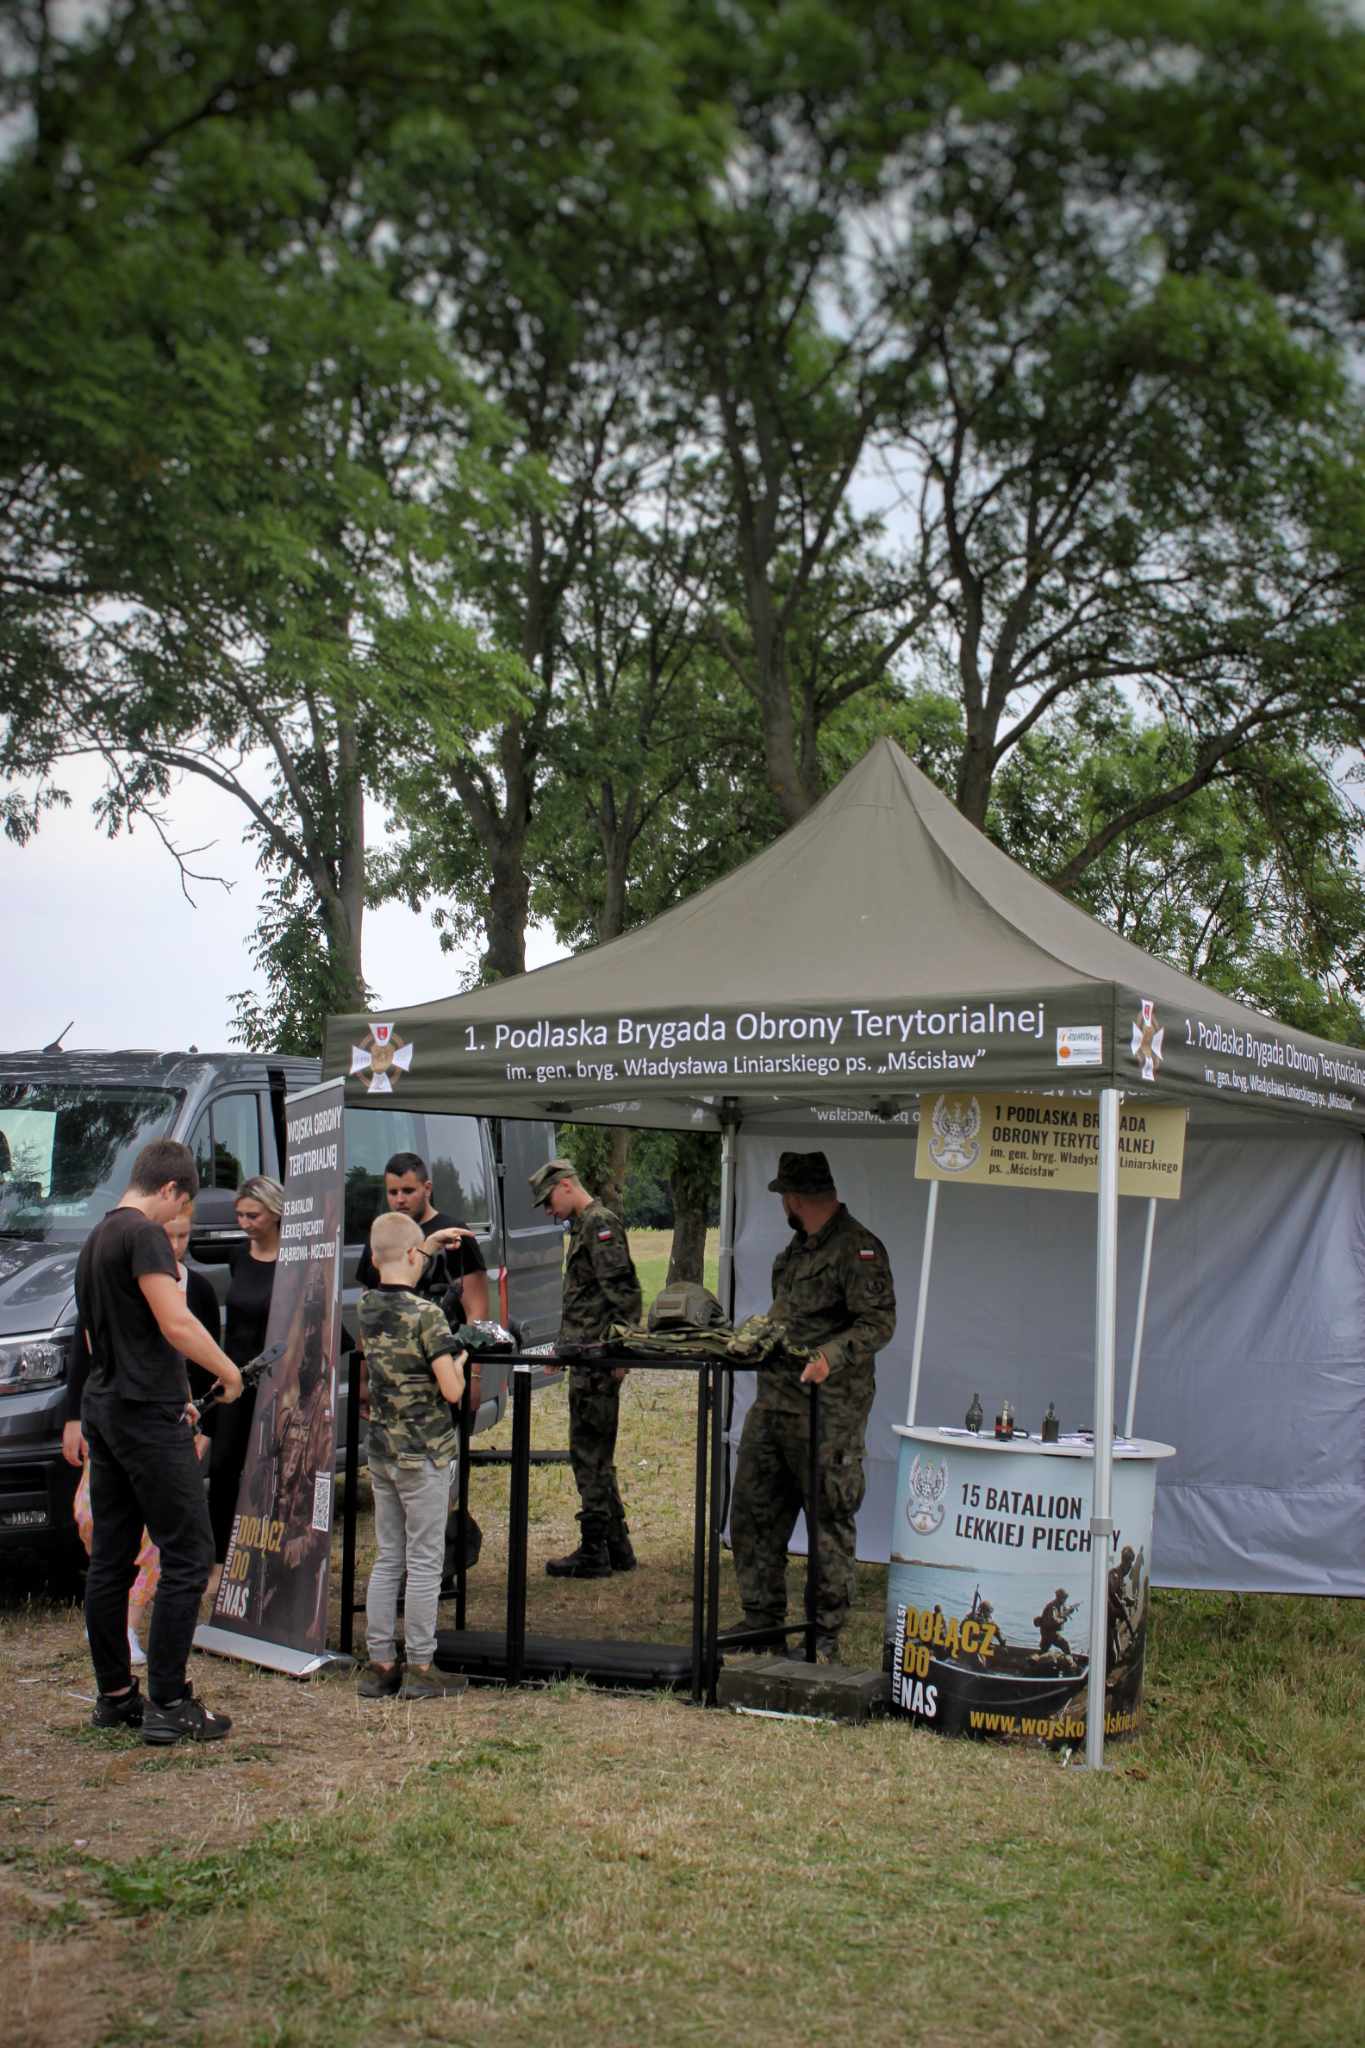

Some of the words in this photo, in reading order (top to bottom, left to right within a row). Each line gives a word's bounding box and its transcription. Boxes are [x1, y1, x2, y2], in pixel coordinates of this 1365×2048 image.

[464, 1025, 485, 1051] 1.
[495, 1018, 607, 1049] Podlaska
[617, 1014, 727, 1050] Brygada
[735, 1011, 843, 1044] Obrony
[851, 1002, 1045, 1043] Terytorialnej
[506, 1063, 531, 1080] im.
[536, 1065, 572, 1083] gen.
[576, 1060, 618, 1082] bryg.
[624, 1056, 728, 1081] Władysława
[734, 1052, 840, 1077] Liniarskiego
[846, 1058, 872, 1076] ps.
[877, 1048, 986, 1074] „Mścisław”
[1185, 1019, 1196, 1046] 1.
[1198, 1022, 1244, 1056] Podlaska
[1246, 1033, 1284, 1068] Brygada
[1286, 1044, 1319, 1079] Obrony
[1318, 1053, 1365, 1087] Terytorialne
[1204, 1065, 1216, 1083] im.
[1217, 1070, 1232, 1088] gen.
[1232, 1069, 1249, 1093] bryg.
[1250, 1074, 1285, 1100] Władysława
[287, 1115, 313, 1144] WOJSKA
[314, 1105, 342, 1136] OBRONY
[995, 1105, 1001, 1121] 1
[1007, 1106, 1078, 1128] PODLASKA
[1083, 1113, 1147, 1133] BRADA
[992, 1126, 1049, 1147] OBRONY
[1054, 1131, 1155, 1155] TERYTOALNEJ
[289, 1144, 337, 1176] TERYTORIALNEJ
[989, 1164, 1003, 1176] ps.
[990, 1146, 1003, 1158] im.
[1008, 1149, 1029, 1161] gen.
[1032, 1149, 1057, 1164] bryg.
[1060, 1151, 1098, 1167] Władysł
[1120, 1156, 1178, 1174] Liniarskiego
[284, 1201, 291, 1216] 15
[962, 1483, 980, 1507] 15
[985, 1487, 1082, 1520] BATALION
[955, 1514, 1025, 1548] LEKKIEJ
[1032, 1526, 1121, 1552] PIECHY
[229, 1549, 250, 1581] DO
[222, 1584, 250, 1618] NAS
[906, 1605, 998, 1658] DOŁĄCZ
[903, 1641, 930, 1679] DO
[901, 1676, 938, 1718] NAS
